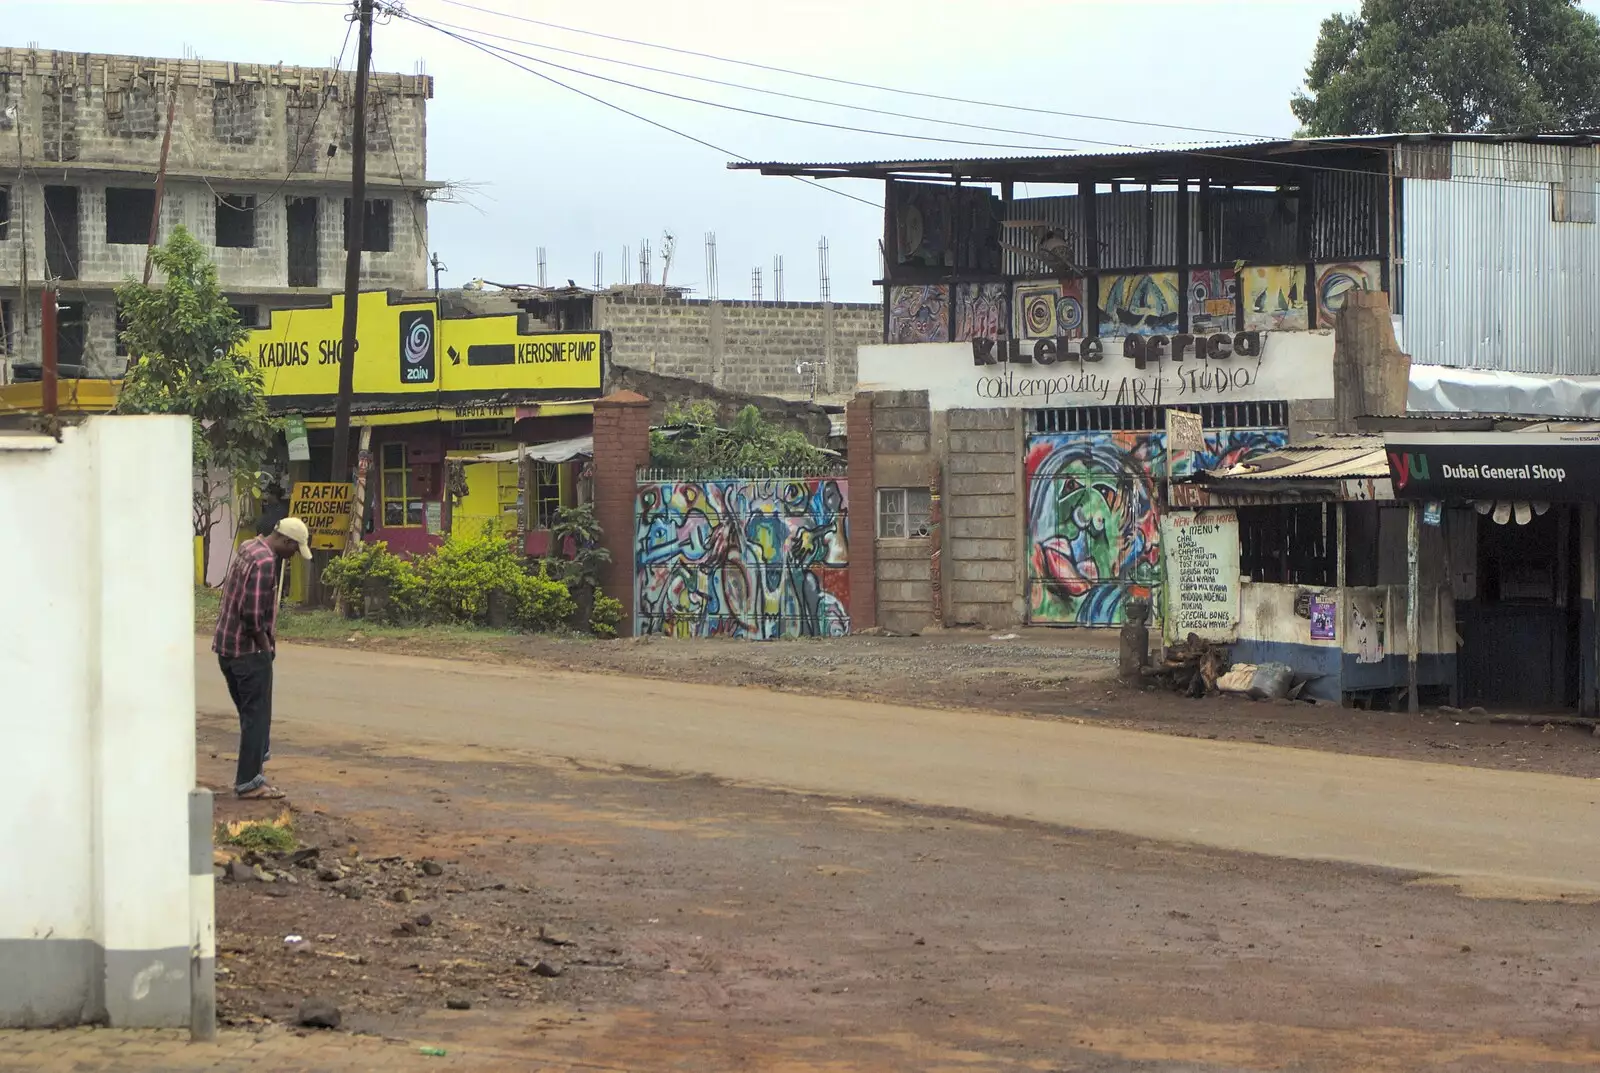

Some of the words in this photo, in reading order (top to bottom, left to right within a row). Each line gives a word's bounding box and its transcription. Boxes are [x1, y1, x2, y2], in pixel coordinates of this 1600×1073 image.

[259, 341, 309, 368] KADUAS
[518, 342, 566, 364] KEROSINE
[568, 341, 596, 362] PUMP
[1177, 364, 1250, 396] STUDIO
[455, 407, 485, 418] MAFUTA
[488, 407, 504, 416] TAA
[1390, 452, 1430, 489] yu
[1442, 464, 1479, 479] Dubai
[1481, 464, 1530, 480] General
[1533, 465, 1566, 482] Shop
[301, 485, 349, 500] RAFIKI
[292, 500, 351, 514] KEROSENE
[301, 515, 334, 528] PUMP
[1189, 525, 1213, 535] MENU
[1178, 547, 1204, 555] CHAPATI
[1181, 611, 1208, 620] SPECIAL
[1209, 611, 1230, 620] BONES
[1181, 620, 1203, 629] CAKES
